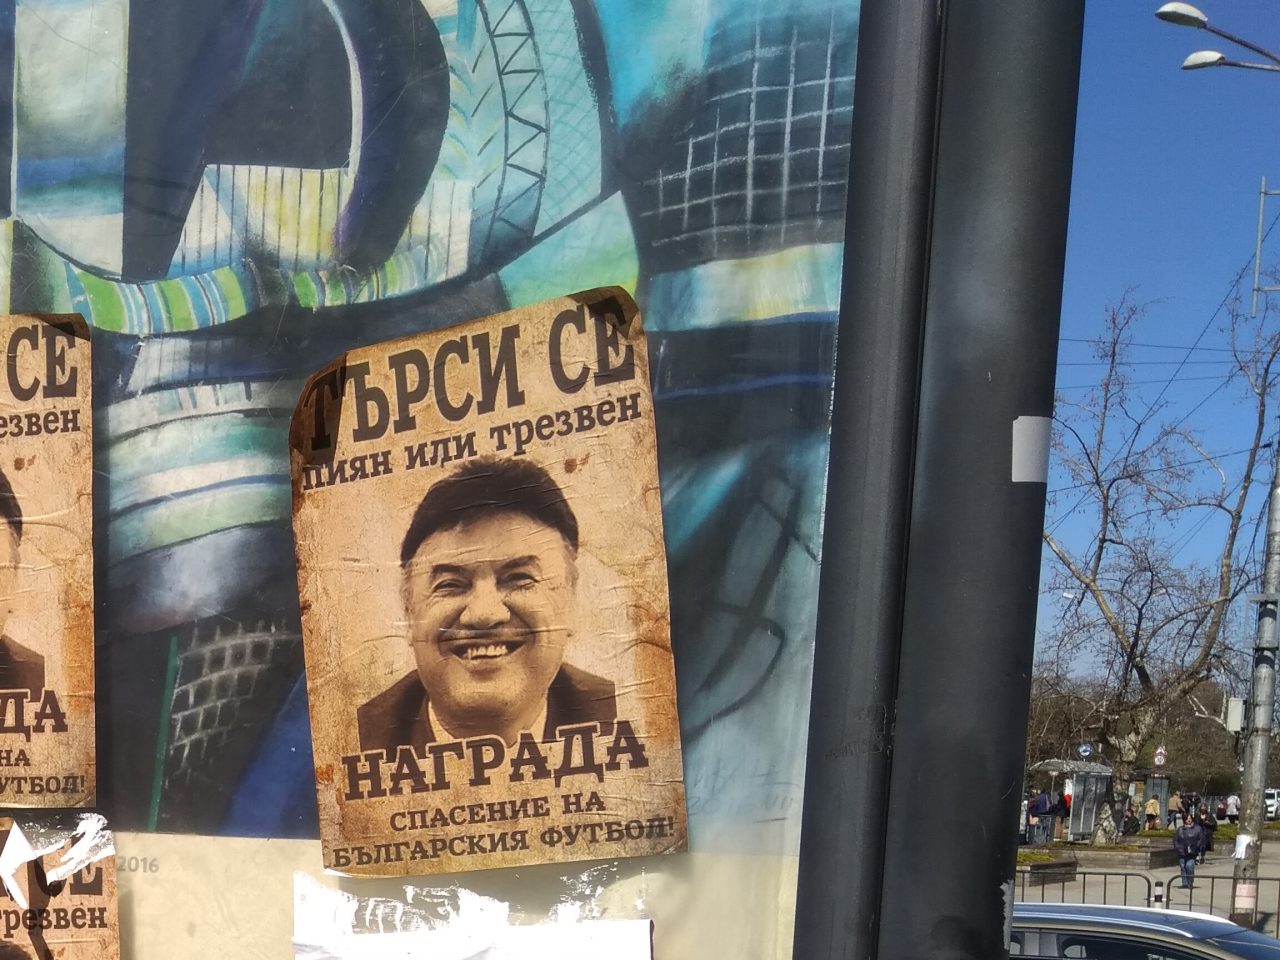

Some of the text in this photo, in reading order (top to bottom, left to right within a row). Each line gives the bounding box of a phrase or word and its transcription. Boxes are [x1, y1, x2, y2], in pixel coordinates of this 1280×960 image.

[6, 323, 79, 401] СЕ
[305, 298, 636, 451] ТЪРСИ СЕ
[302, 391, 642, 491] пиян или трезвен
[341, 719, 650, 802] НАГРАДА
[333, 816, 676, 868] БЪЛГАРСКИЯ ФУТБОЛ!
[390, 790, 607, 832] СПАСЕНИЕ НА
